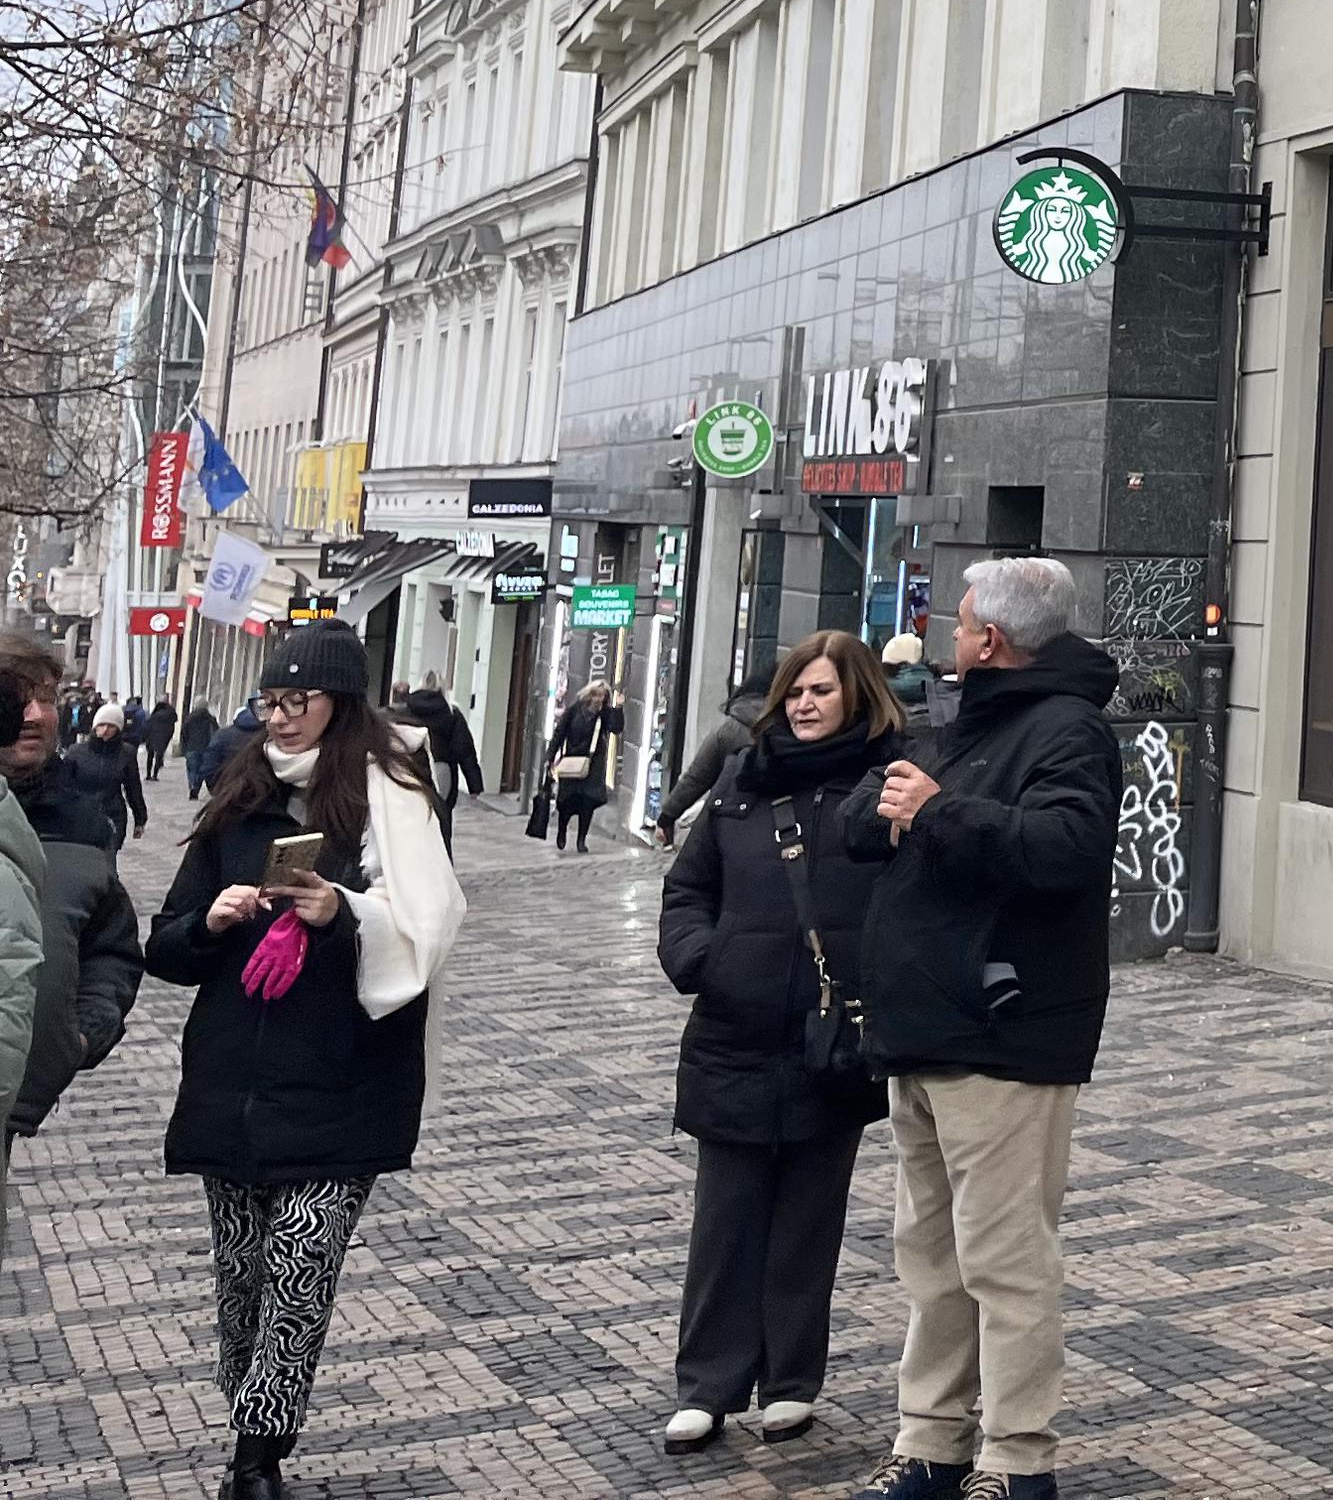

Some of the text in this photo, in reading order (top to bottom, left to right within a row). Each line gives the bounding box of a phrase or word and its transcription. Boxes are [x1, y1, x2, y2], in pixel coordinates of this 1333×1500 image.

[706, 406, 763, 426] LINK 86
[803, 357, 921, 457] LINK 86
[574, 609, 632, 626] MARKET
